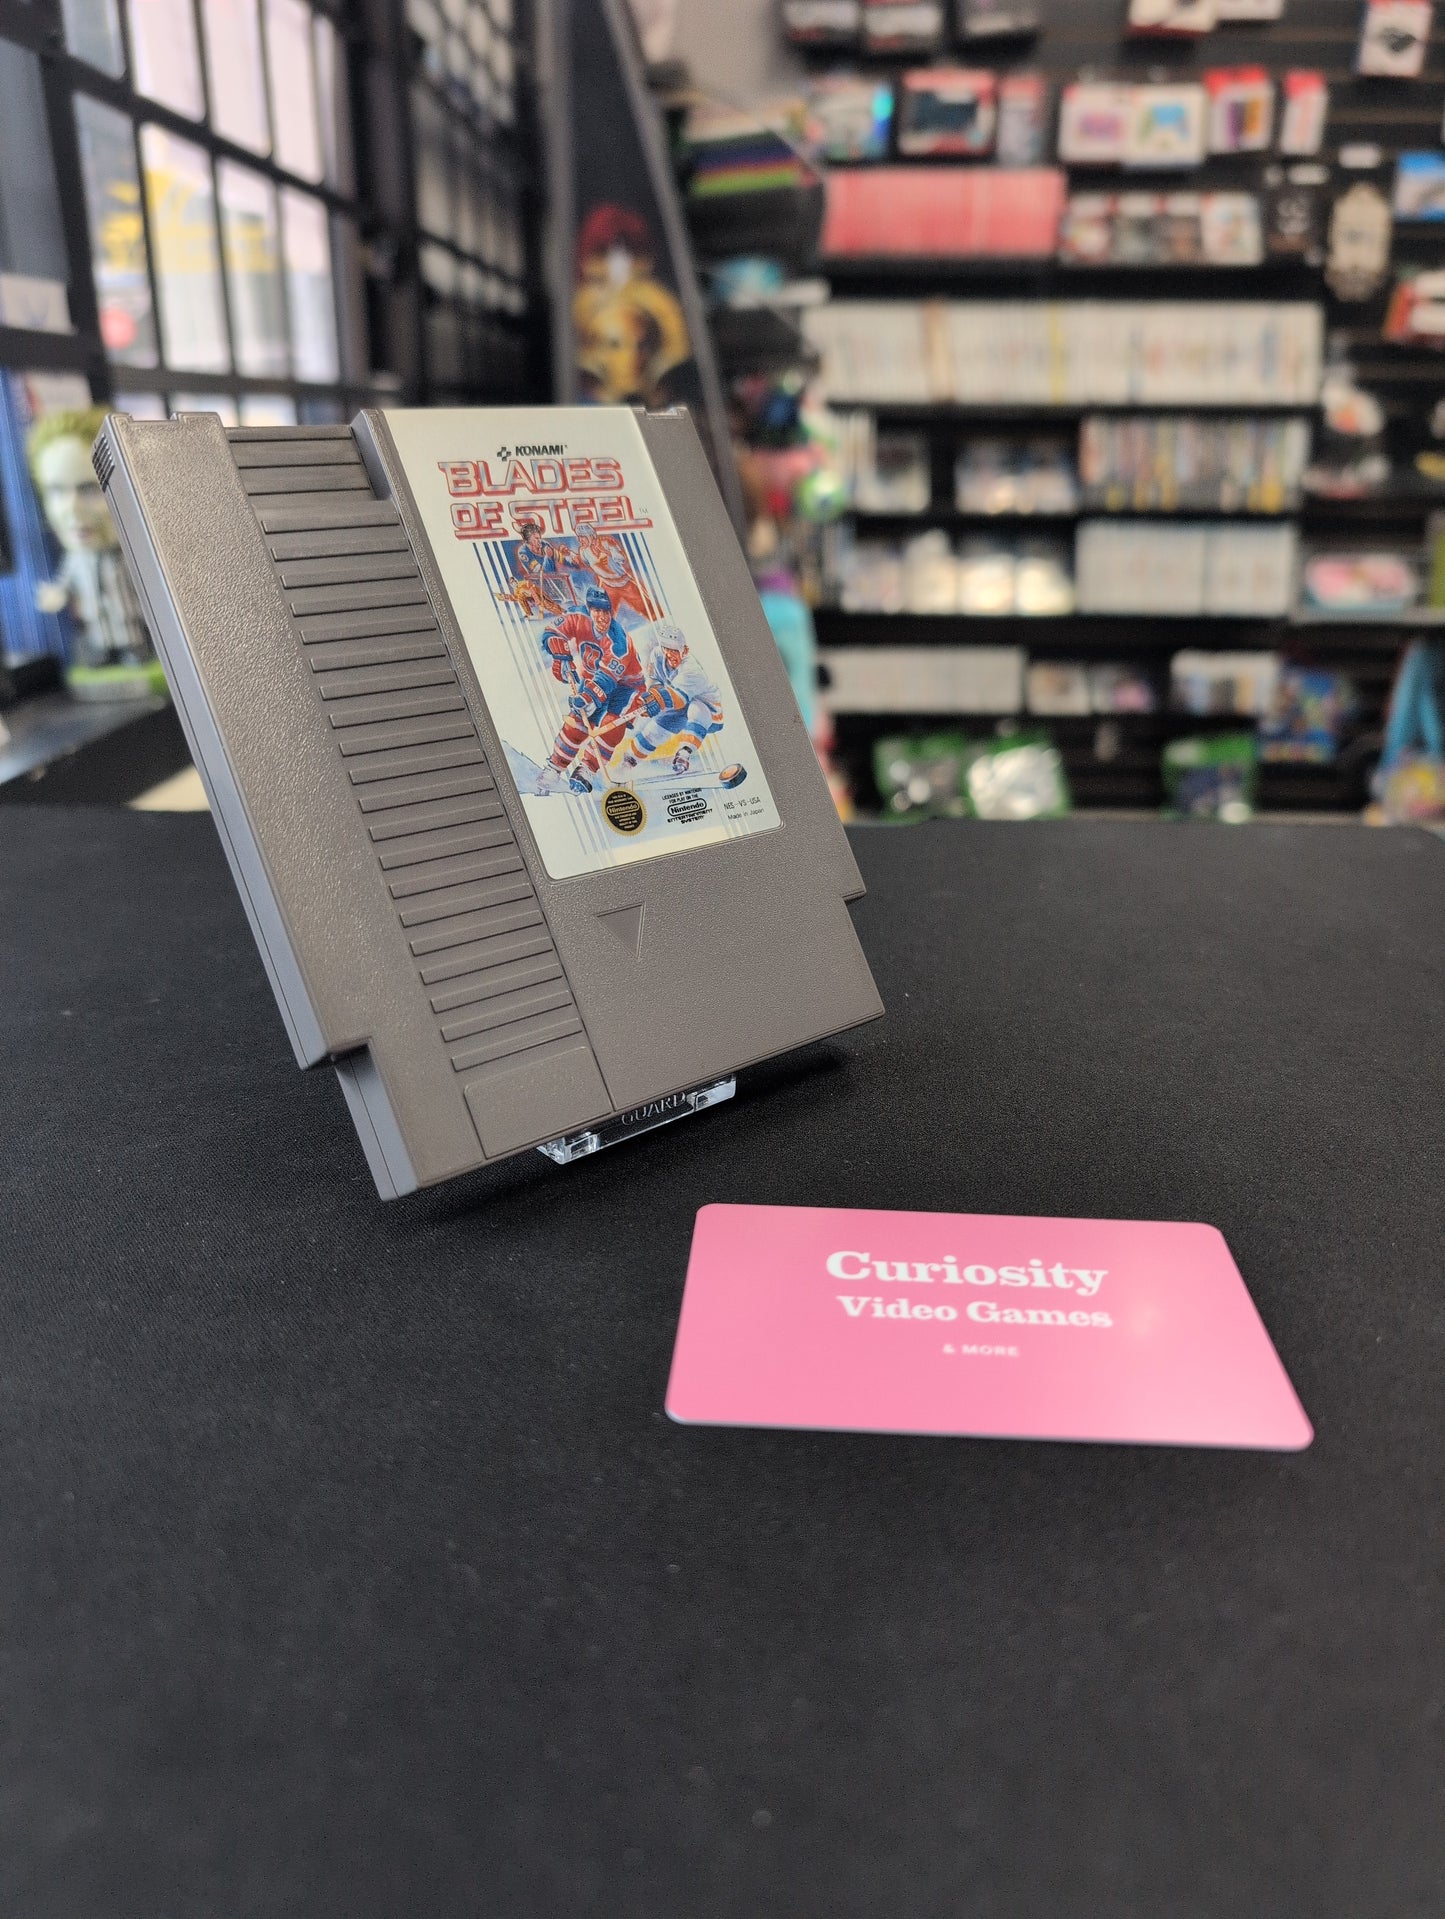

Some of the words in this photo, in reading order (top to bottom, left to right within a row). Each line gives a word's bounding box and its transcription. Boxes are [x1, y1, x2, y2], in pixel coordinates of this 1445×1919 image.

[515, 444, 564, 457] KONAMI
[437, 457, 624, 498] BLADES
[450, 501, 509, 540] OF
[508, 495, 654, 536] STEEL
[608, 803, 638, 814] Nintendo
[670, 801, 705, 815] Nintendo
[749, 808, 765, 816] Japan
[826, 1250, 1109, 1297] Curiosity
[836, 1294, 959, 1322] Video
[965, 1300, 1114, 1328] Games
[942, 1343, 957, 1355] &
[961, 1344, 1020, 1357] MORE
